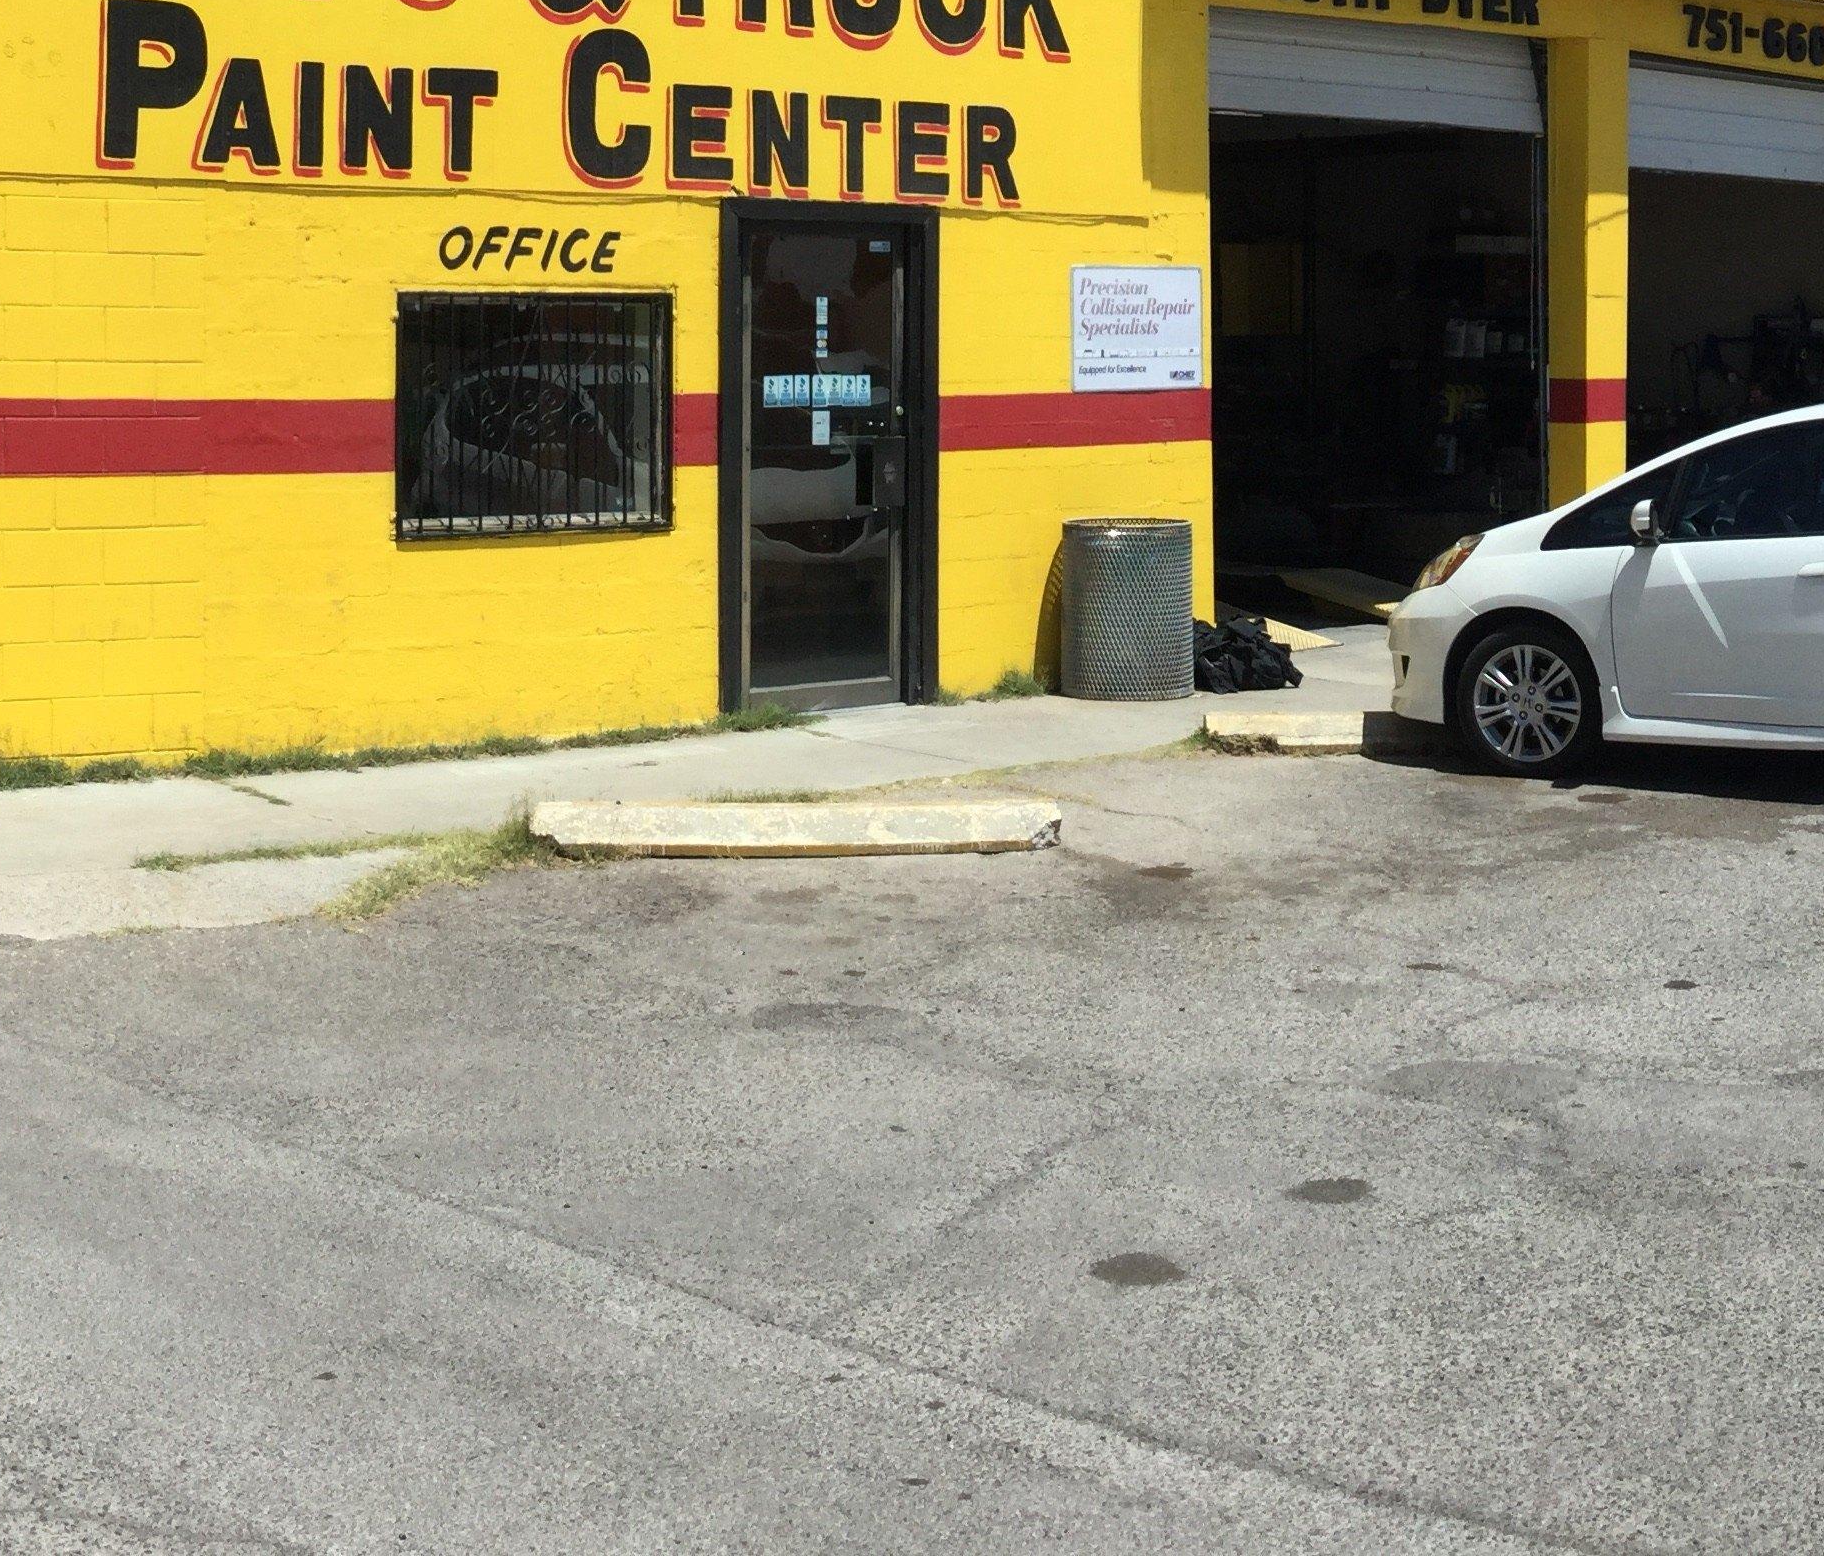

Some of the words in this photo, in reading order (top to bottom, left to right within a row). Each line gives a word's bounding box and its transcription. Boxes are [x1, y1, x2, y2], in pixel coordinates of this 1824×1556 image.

[563, 29, 1020, 207] CENTER
[439, 225, 622, 273] OFFICE
[1079, 277, 1148, 295] Precision
[1080, 297, 1144, 315] Collision
[1145, 297, 1195, 320] Repair
[1079, 317, 1159, 341] Specialists
